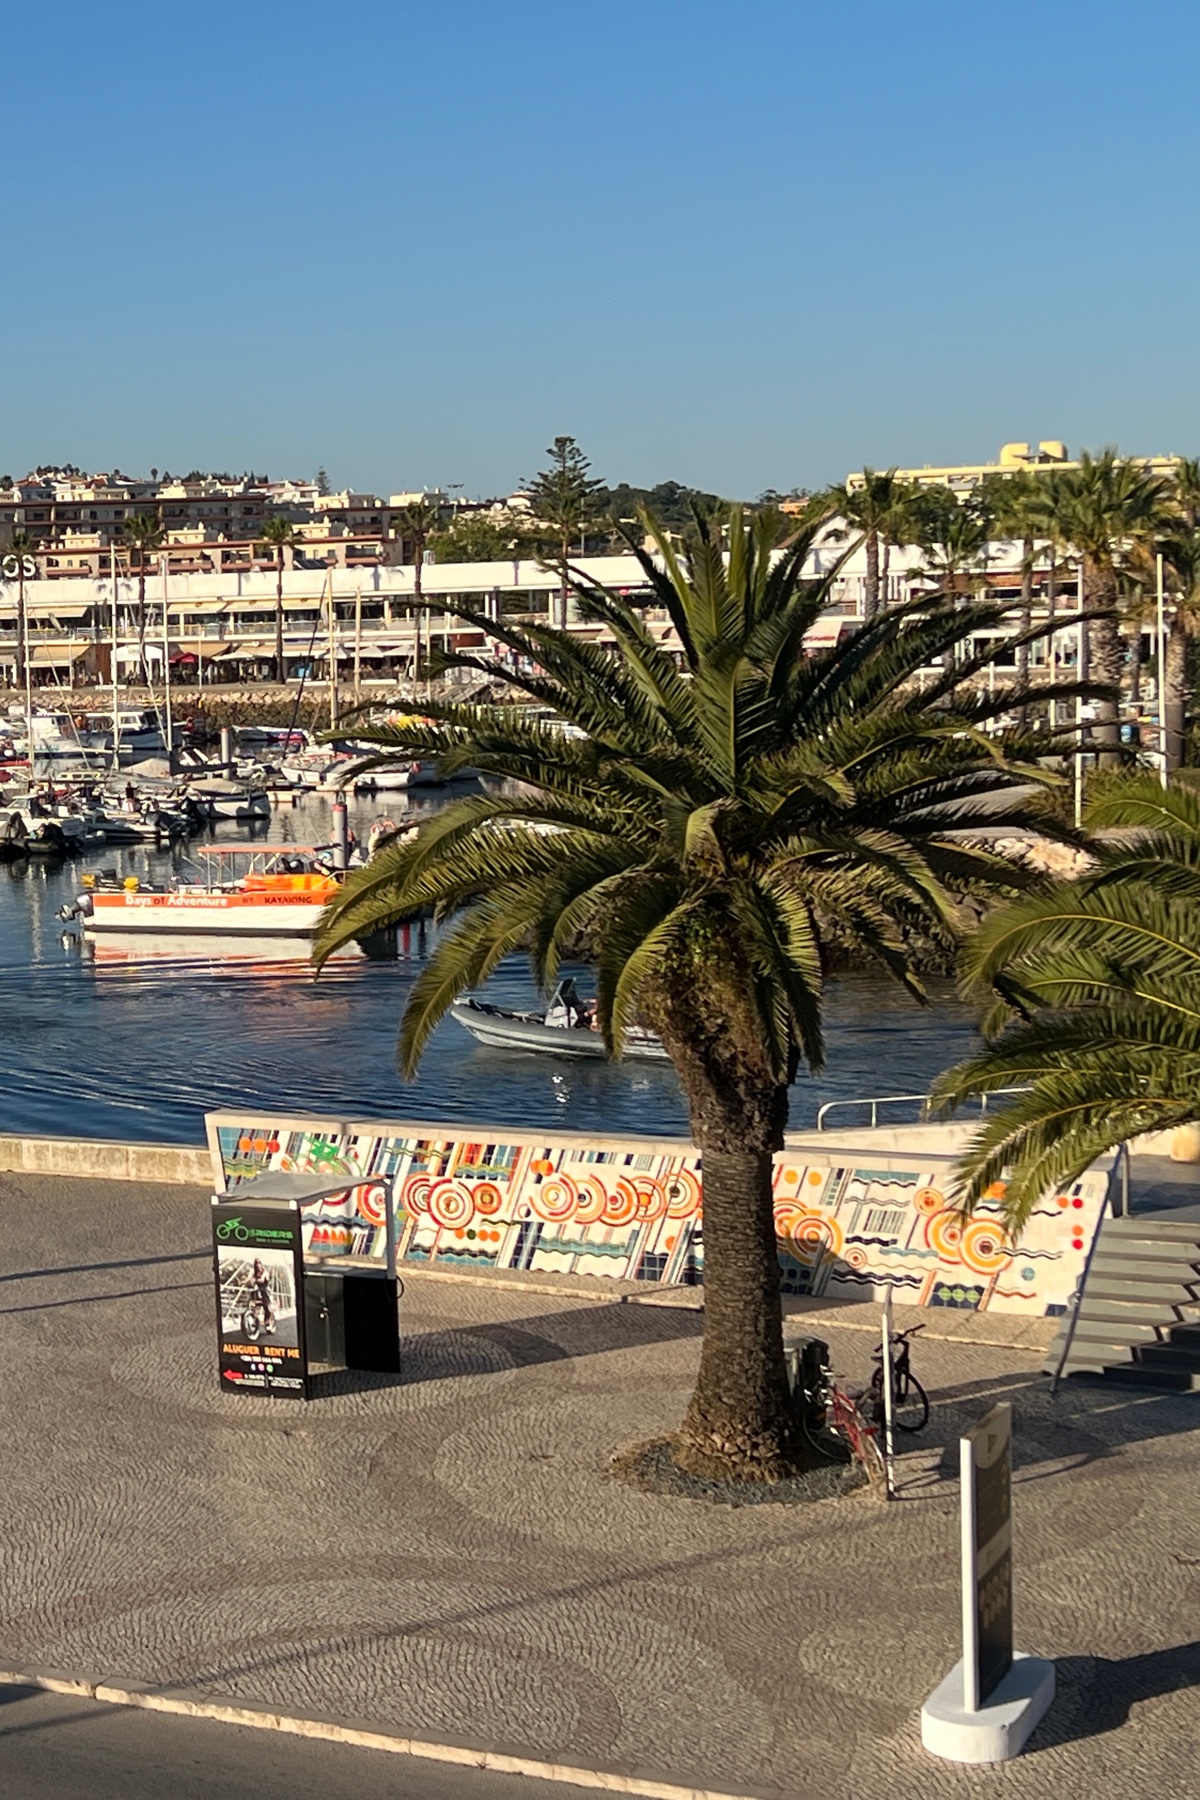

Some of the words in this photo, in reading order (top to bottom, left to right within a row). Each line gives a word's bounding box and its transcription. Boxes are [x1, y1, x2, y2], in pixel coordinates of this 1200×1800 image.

[125, 895, 151, 907] Days
[153, 896, 165, 905] of
[167, 895, 228, 907] Adventure
[223, 1343, 260, 1355] ALUGUER
[264, 1346, 286, 1357] RENT
[287, 1348, 300, 1359] ME
